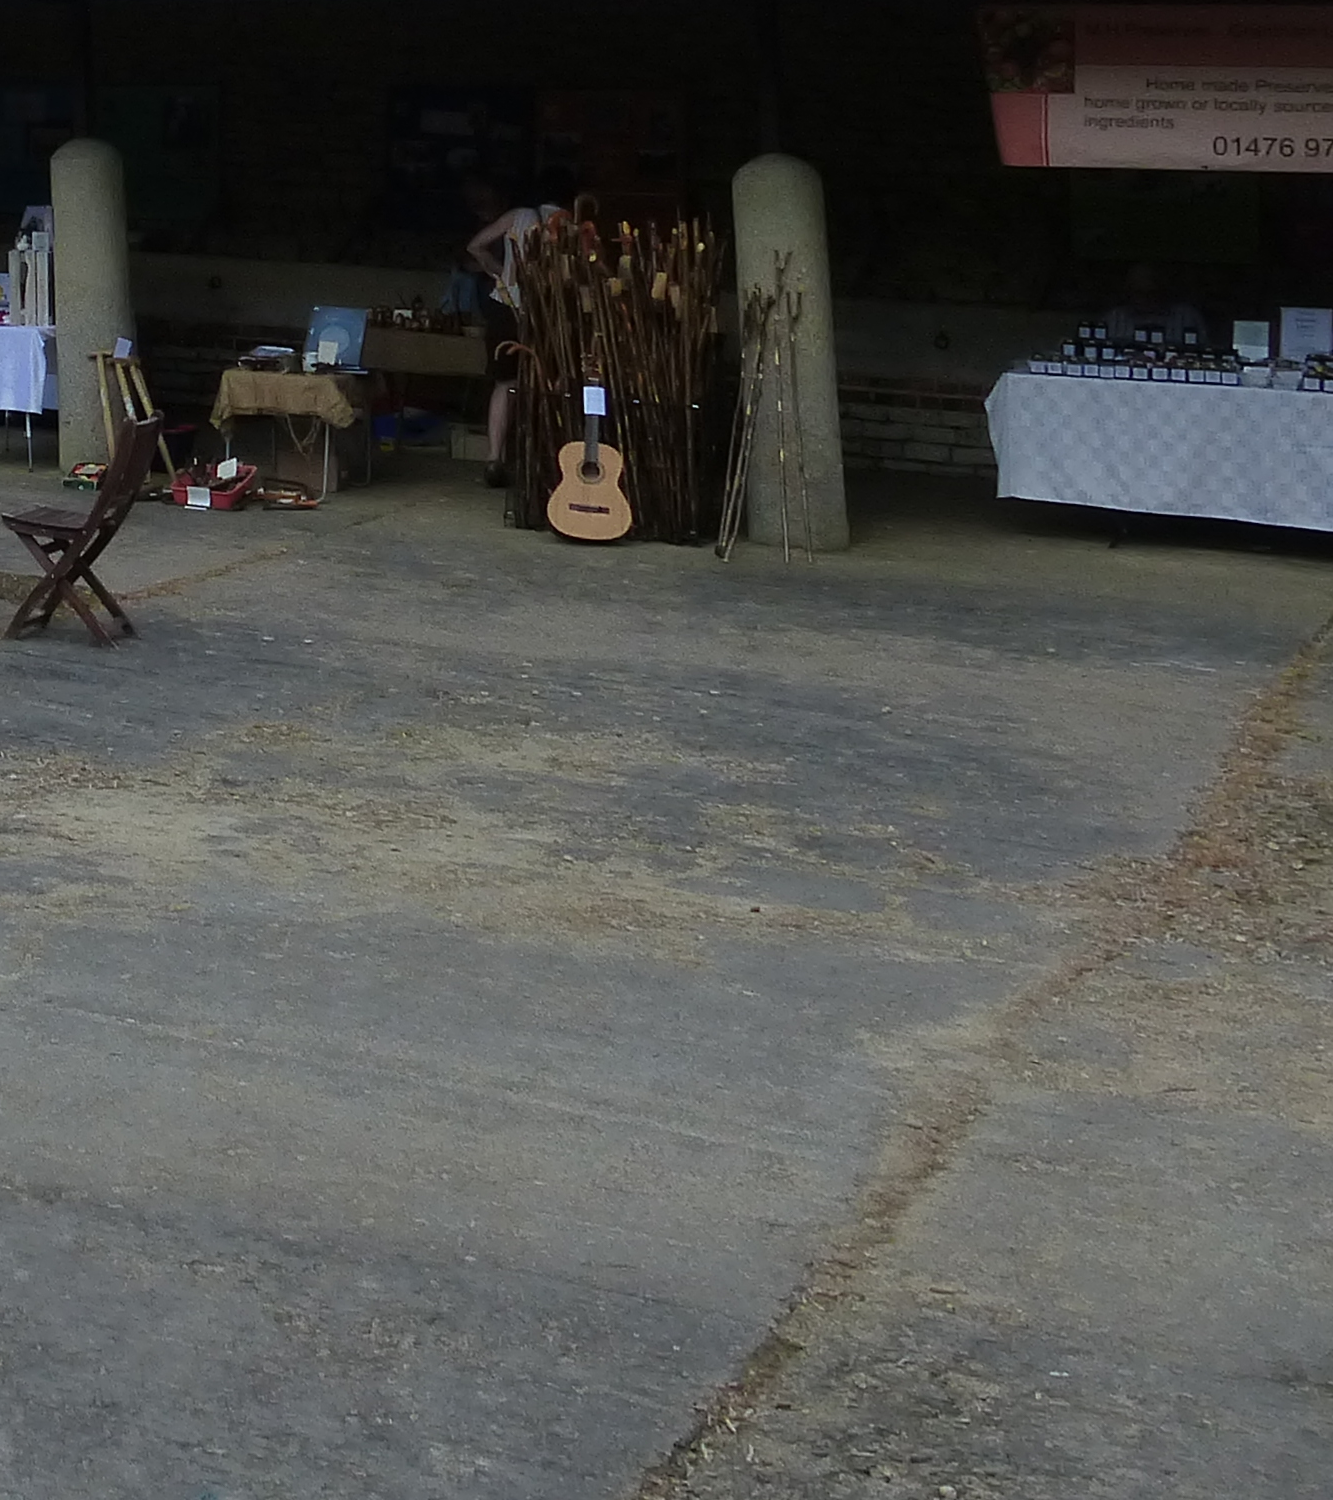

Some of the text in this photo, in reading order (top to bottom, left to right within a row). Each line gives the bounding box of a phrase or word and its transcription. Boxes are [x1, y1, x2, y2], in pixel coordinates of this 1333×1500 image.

[1145, 77, 1196, 92] Home
[1200, 78, 1250, 93] made
[1083, 96, 1130, 110] home
[1134, 98, 1187, 113] grown
[1190, 99, 1209, 111] or
[1213, 97, 1267, 116] locally
[1083, 115, 1175, 131] ingredients
[1212, 135, 1295, 158] 01476
